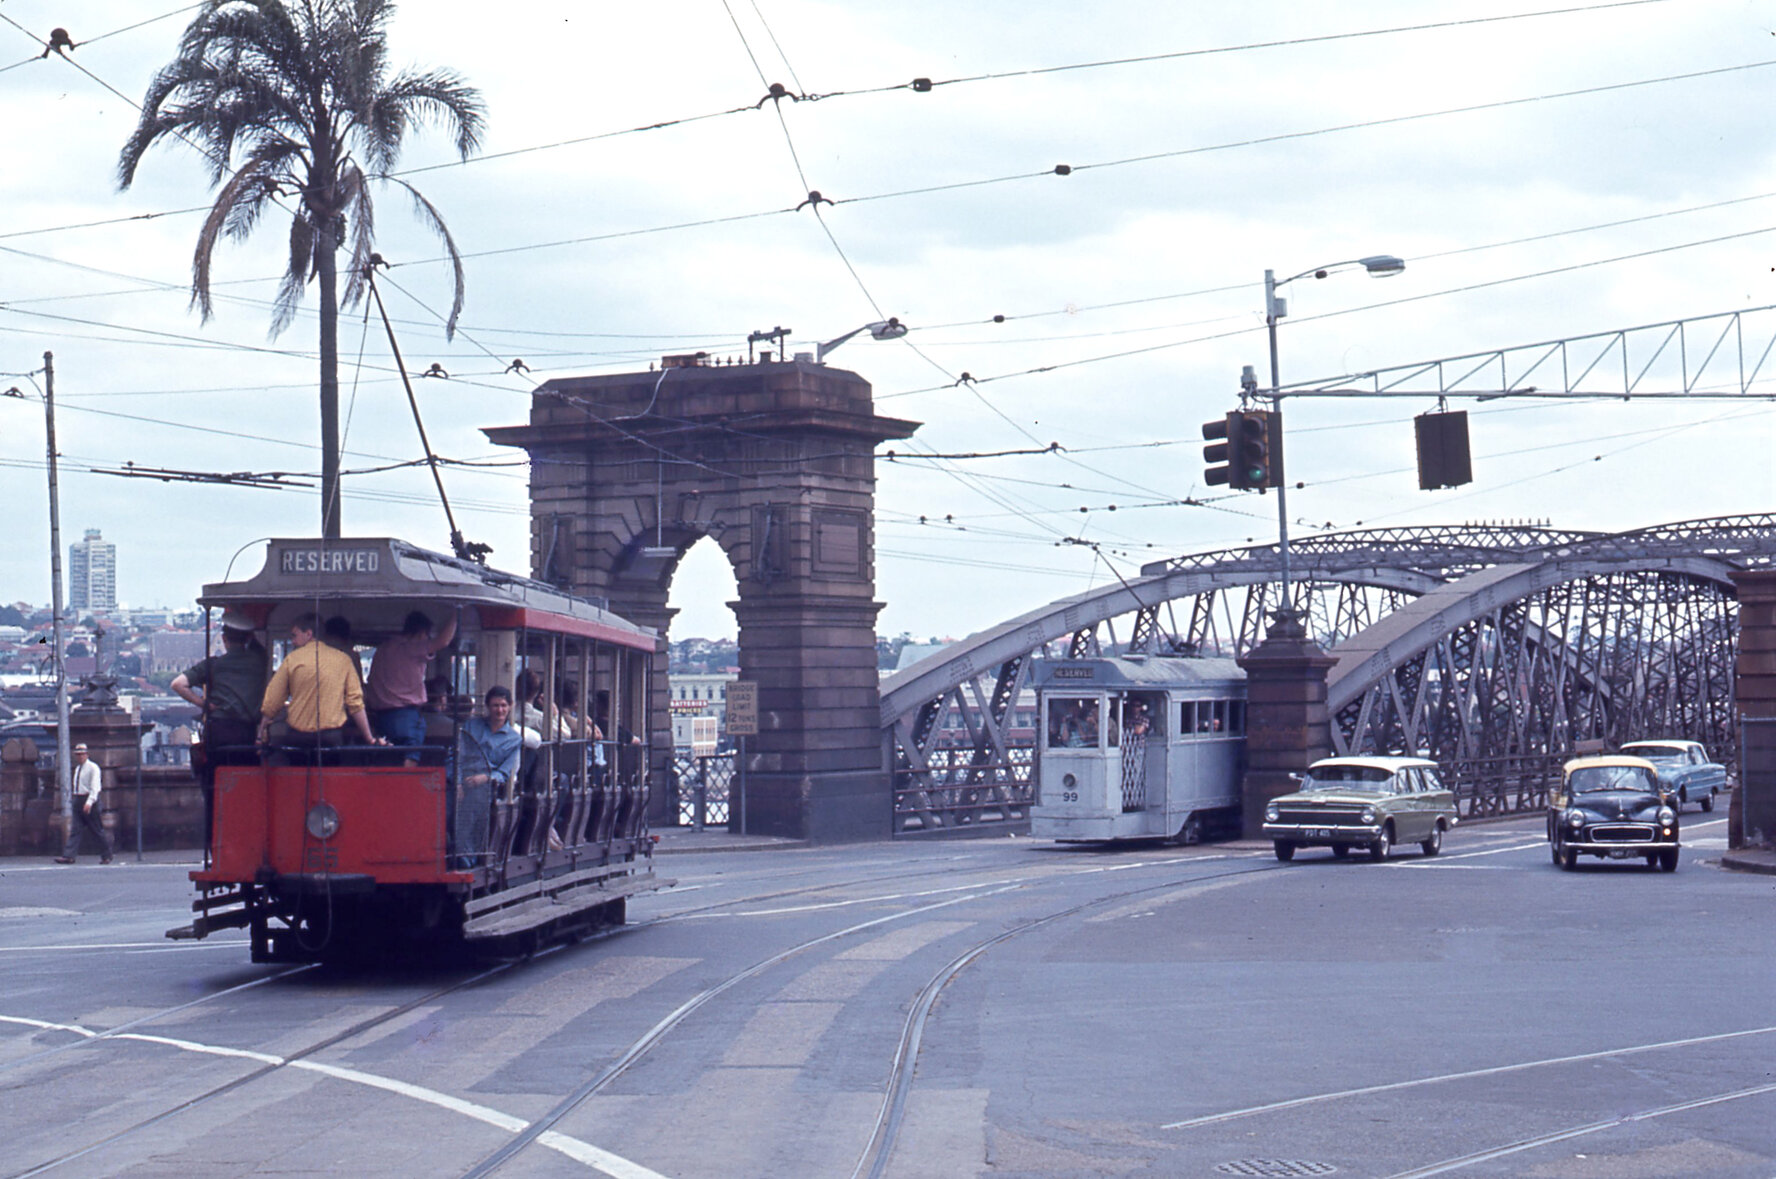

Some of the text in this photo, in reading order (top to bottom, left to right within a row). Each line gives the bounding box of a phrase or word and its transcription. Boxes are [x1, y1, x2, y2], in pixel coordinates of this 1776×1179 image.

[282, 551, 379, 571] RESERVED
[729, 684, 755, 692] BRIDGE
[732, 693, 751, 701] LOAD
[732, 702, 751, 710] LIMIT
[728, 712, 737, 723] 12
[1063, 791, 1078, 802] 99
